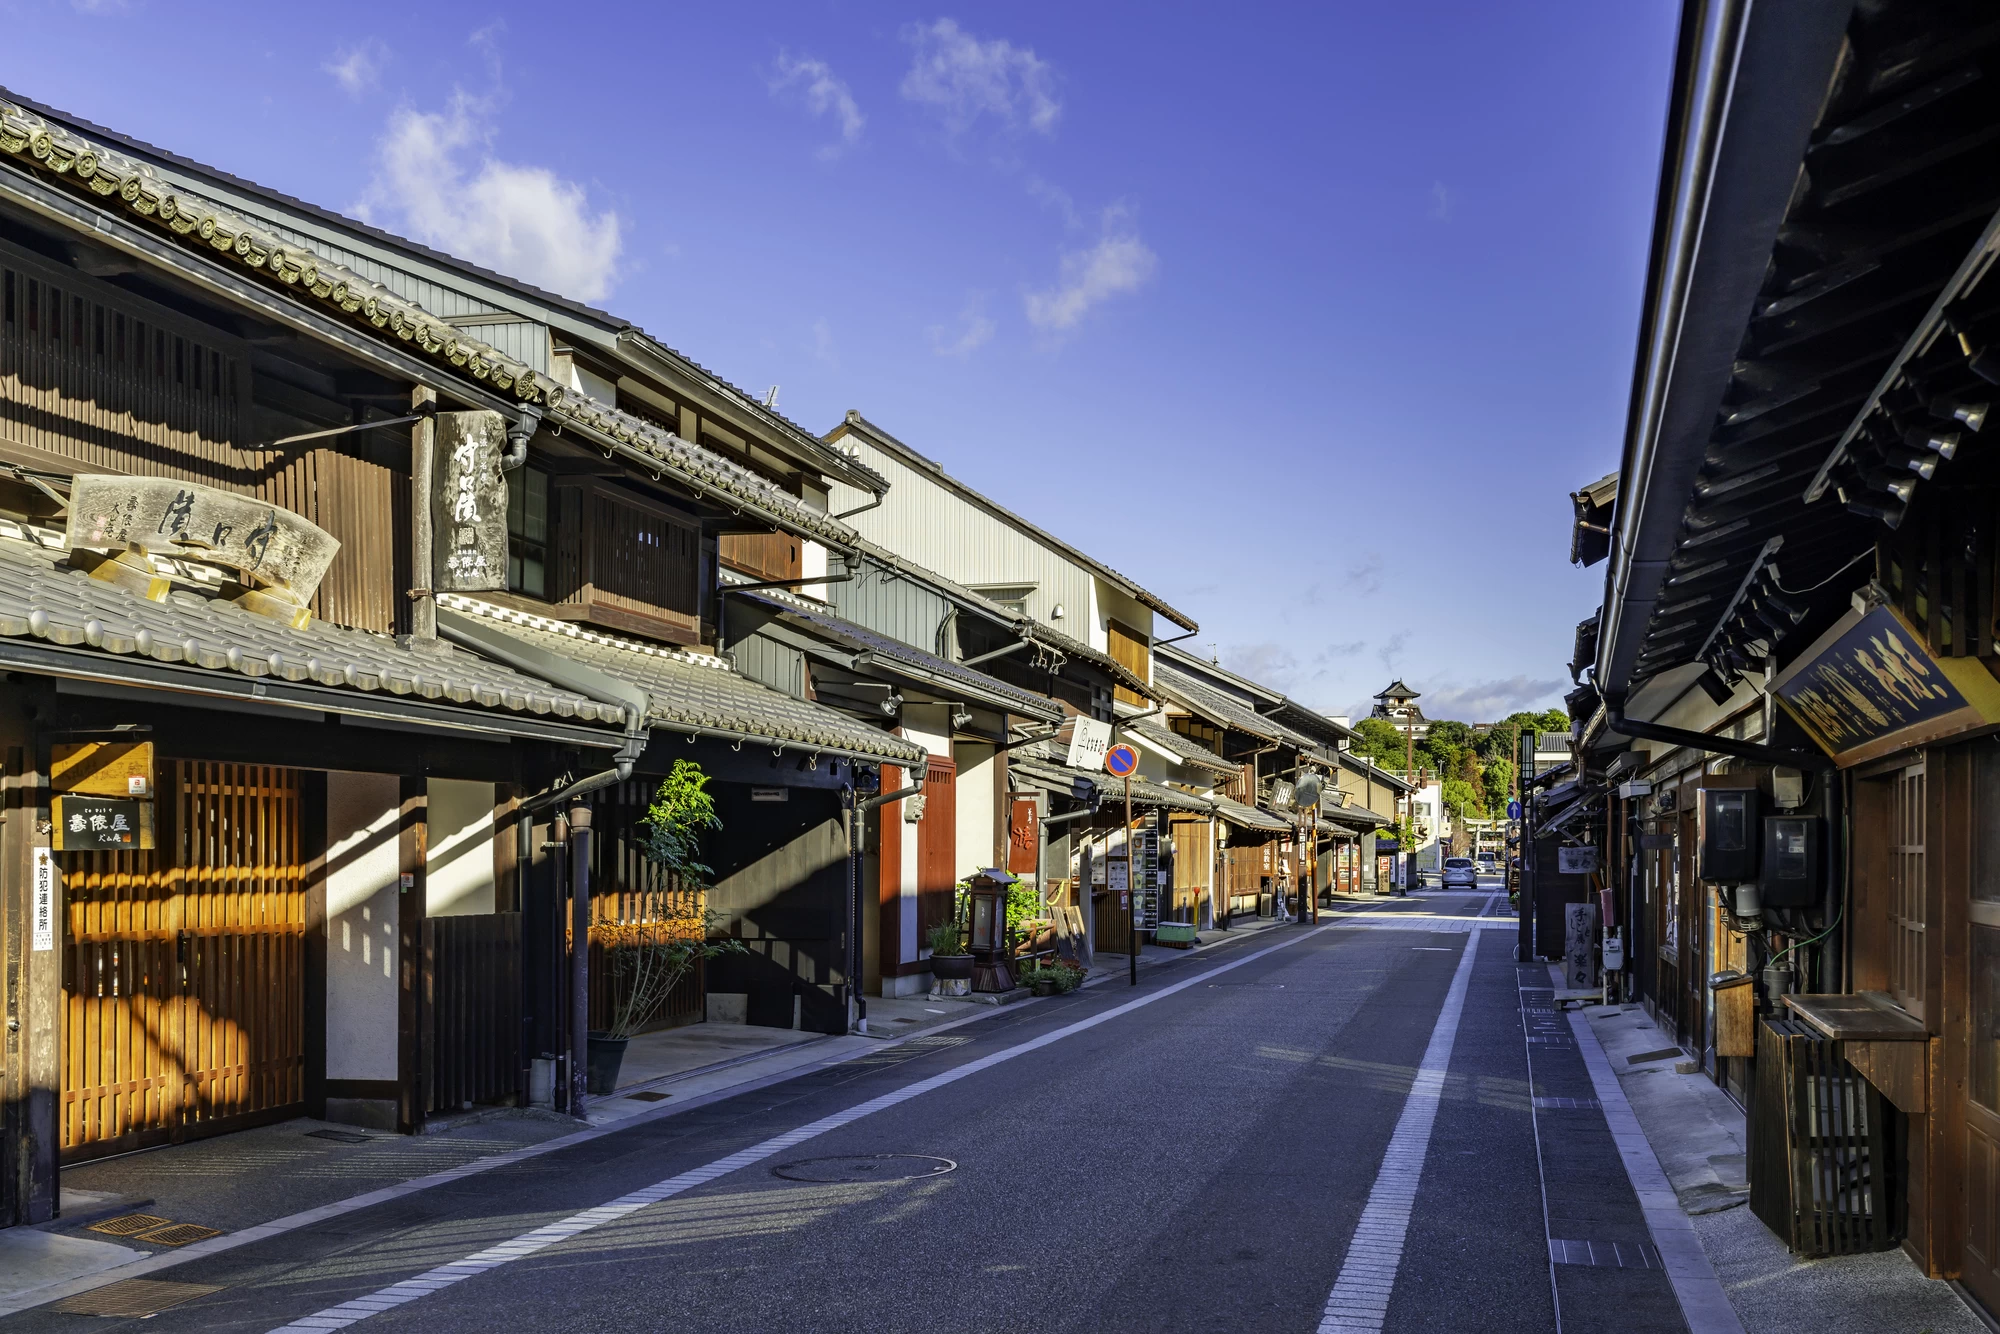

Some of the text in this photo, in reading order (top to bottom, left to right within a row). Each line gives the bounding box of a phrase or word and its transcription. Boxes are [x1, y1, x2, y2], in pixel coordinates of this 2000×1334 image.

[39, 866, 48, 931] 防犯連絡所
